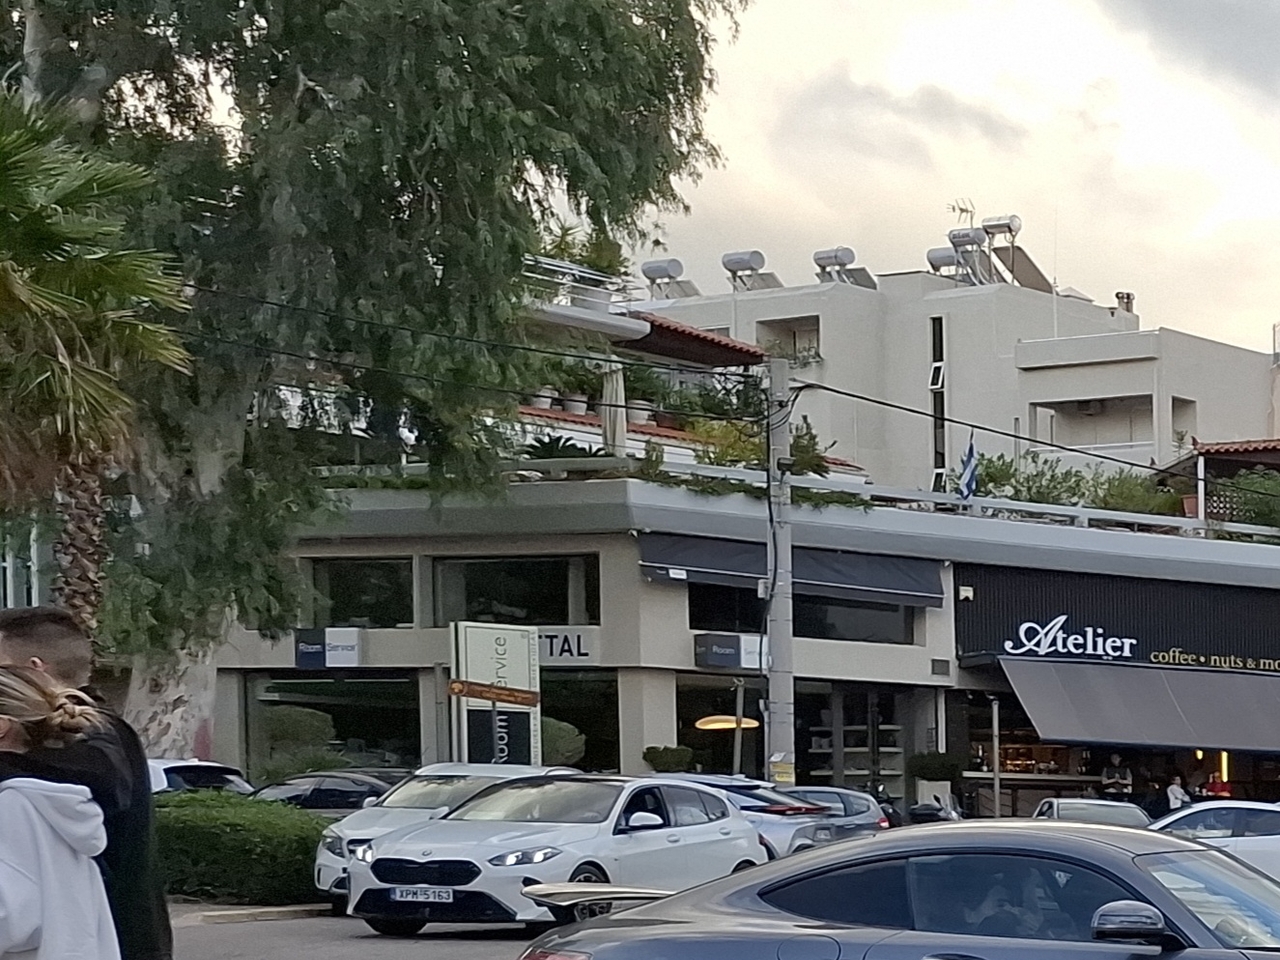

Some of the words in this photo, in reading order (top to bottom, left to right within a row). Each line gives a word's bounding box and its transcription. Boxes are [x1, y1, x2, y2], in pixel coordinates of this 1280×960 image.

[1004, 615, 1137, 656] Atelier
[490, 636, 507, 688] ervice
[1150, 647, 1196, 664] coffee
[1210, 655, 1243, 668] nuts
[1247, 658, 1256, 668] &
